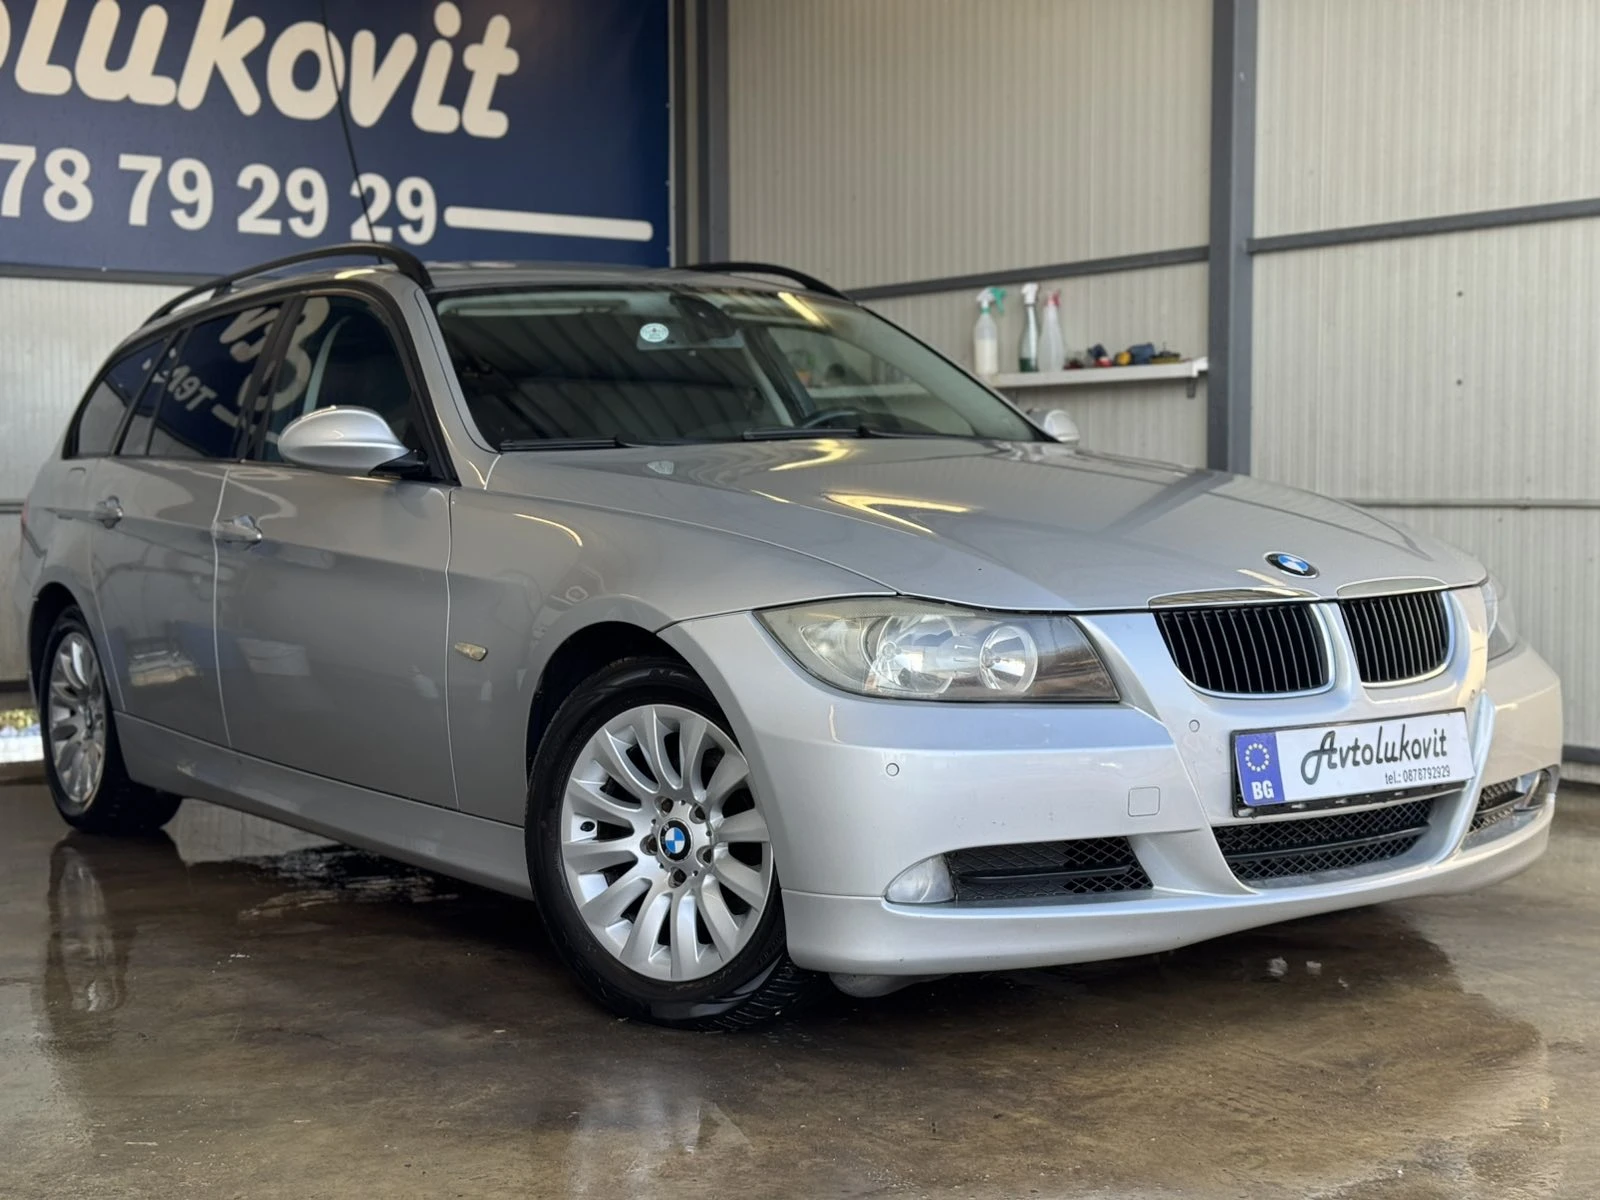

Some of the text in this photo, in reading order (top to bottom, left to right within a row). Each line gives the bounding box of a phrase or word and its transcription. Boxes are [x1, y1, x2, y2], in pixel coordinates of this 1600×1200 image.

[0, 0, 520, 138] lukovit
[118, 153, 214, 231] 79
[236, 163, 329, 239] 29
[349, 172, 438, 245] 29
[1301, 724, 1447, 785] Avtolukovit
[1403, 765, 1450, 783] 0878792929
[1251, 780, 1274, 800] BG
